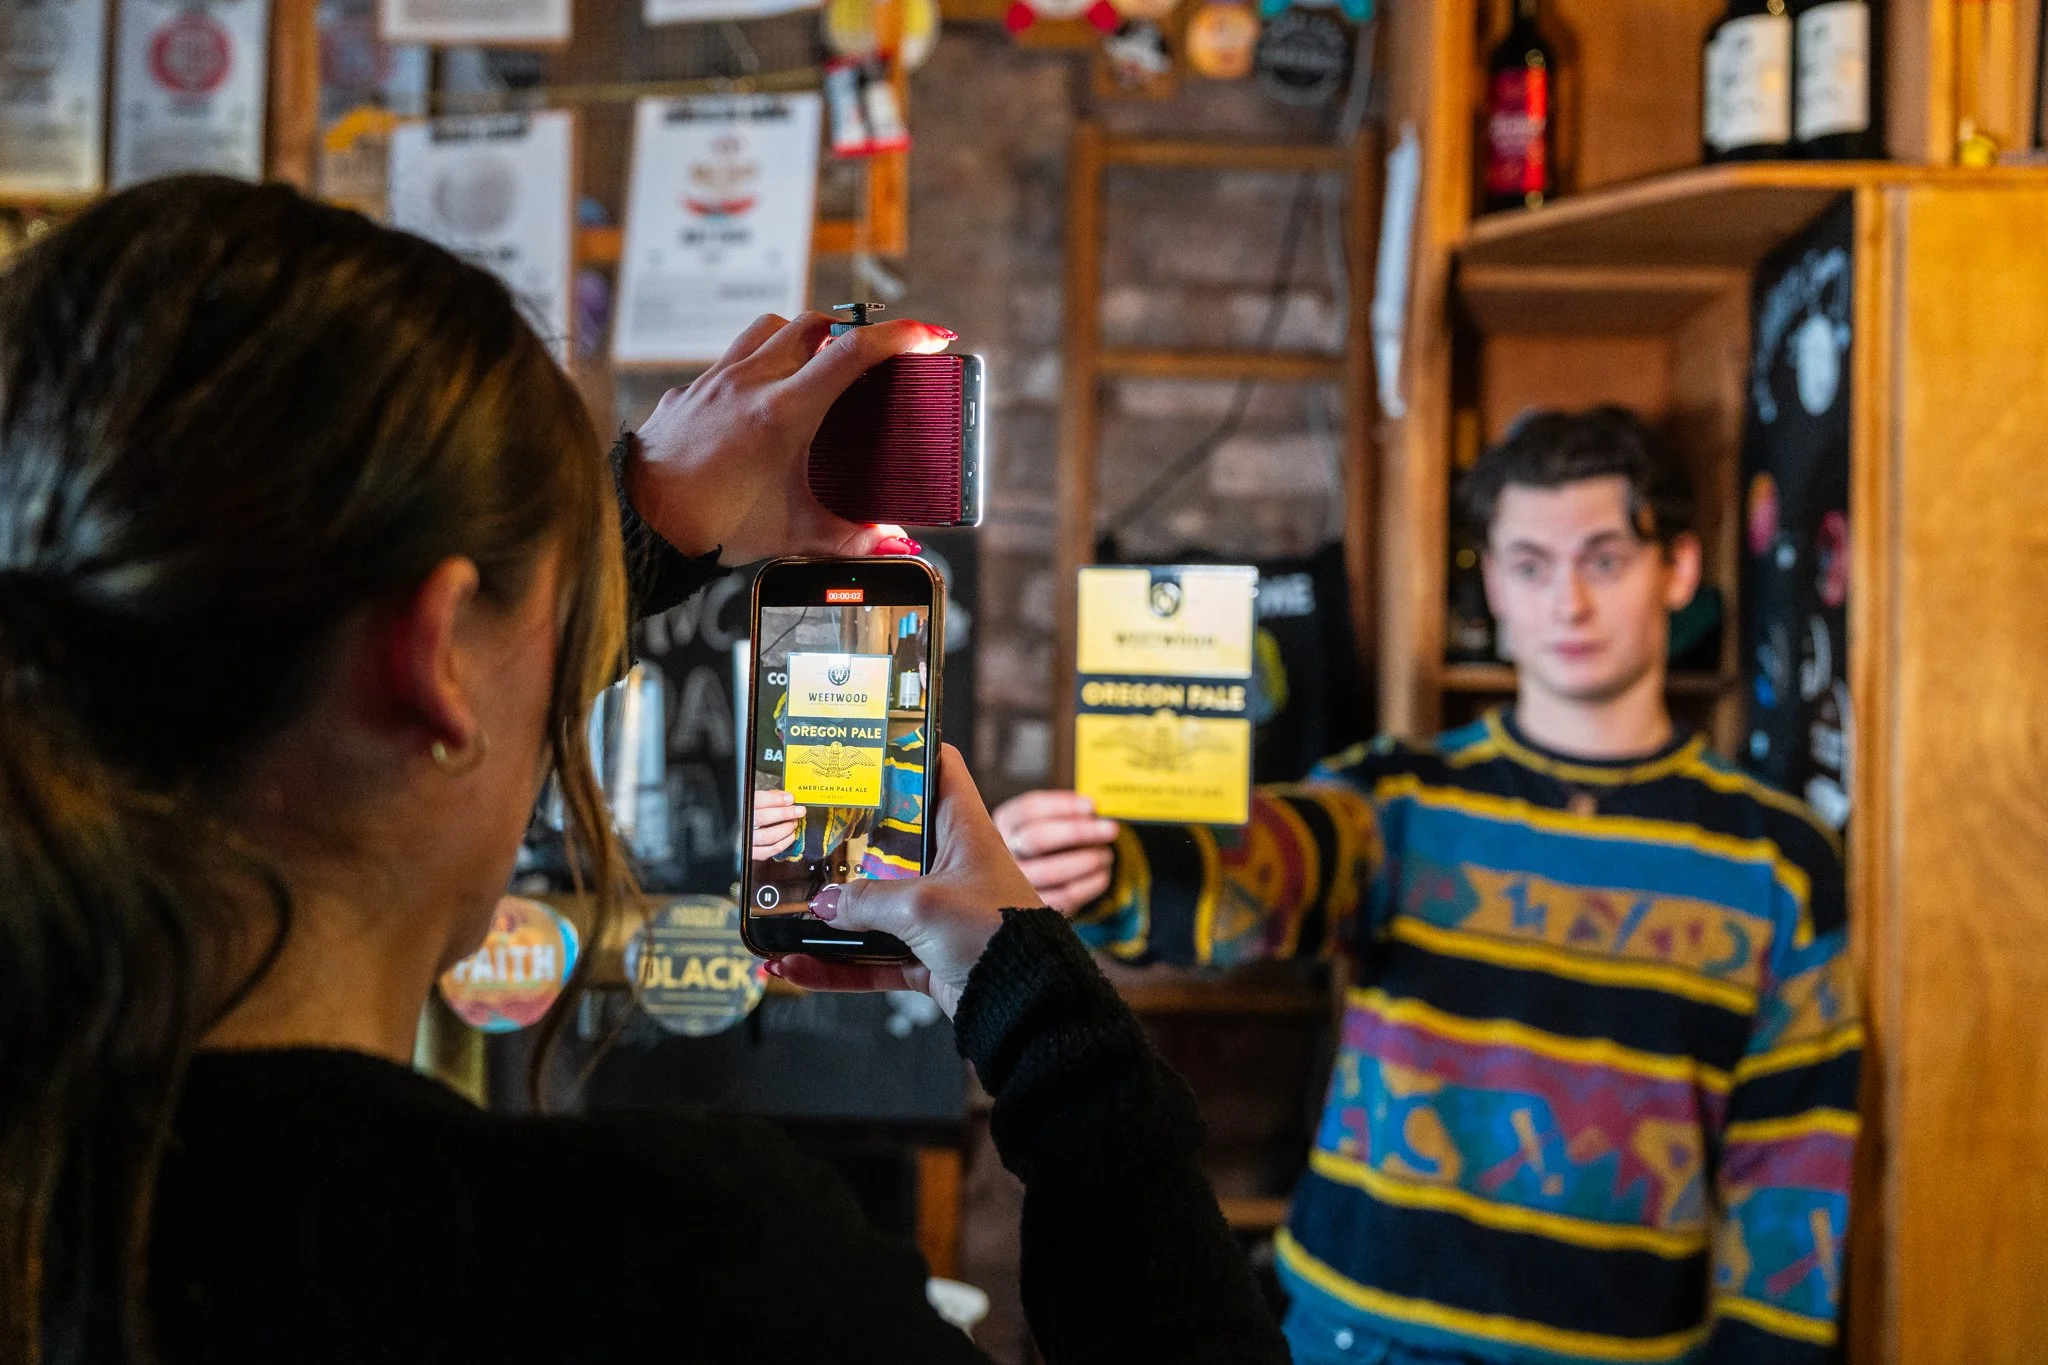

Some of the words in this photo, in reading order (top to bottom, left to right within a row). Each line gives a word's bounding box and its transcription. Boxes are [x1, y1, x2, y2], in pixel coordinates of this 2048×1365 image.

[828, 592, 861, 600] 00:00:02
[808, 692, 868, 703] WEETWOOD
[1081, 681, 1185, 708] OREGON
[1187, 684, 1246, 711] PALE
[790, 725, 847, 739] OREGON
[851, 727, 882, 739] PALE
